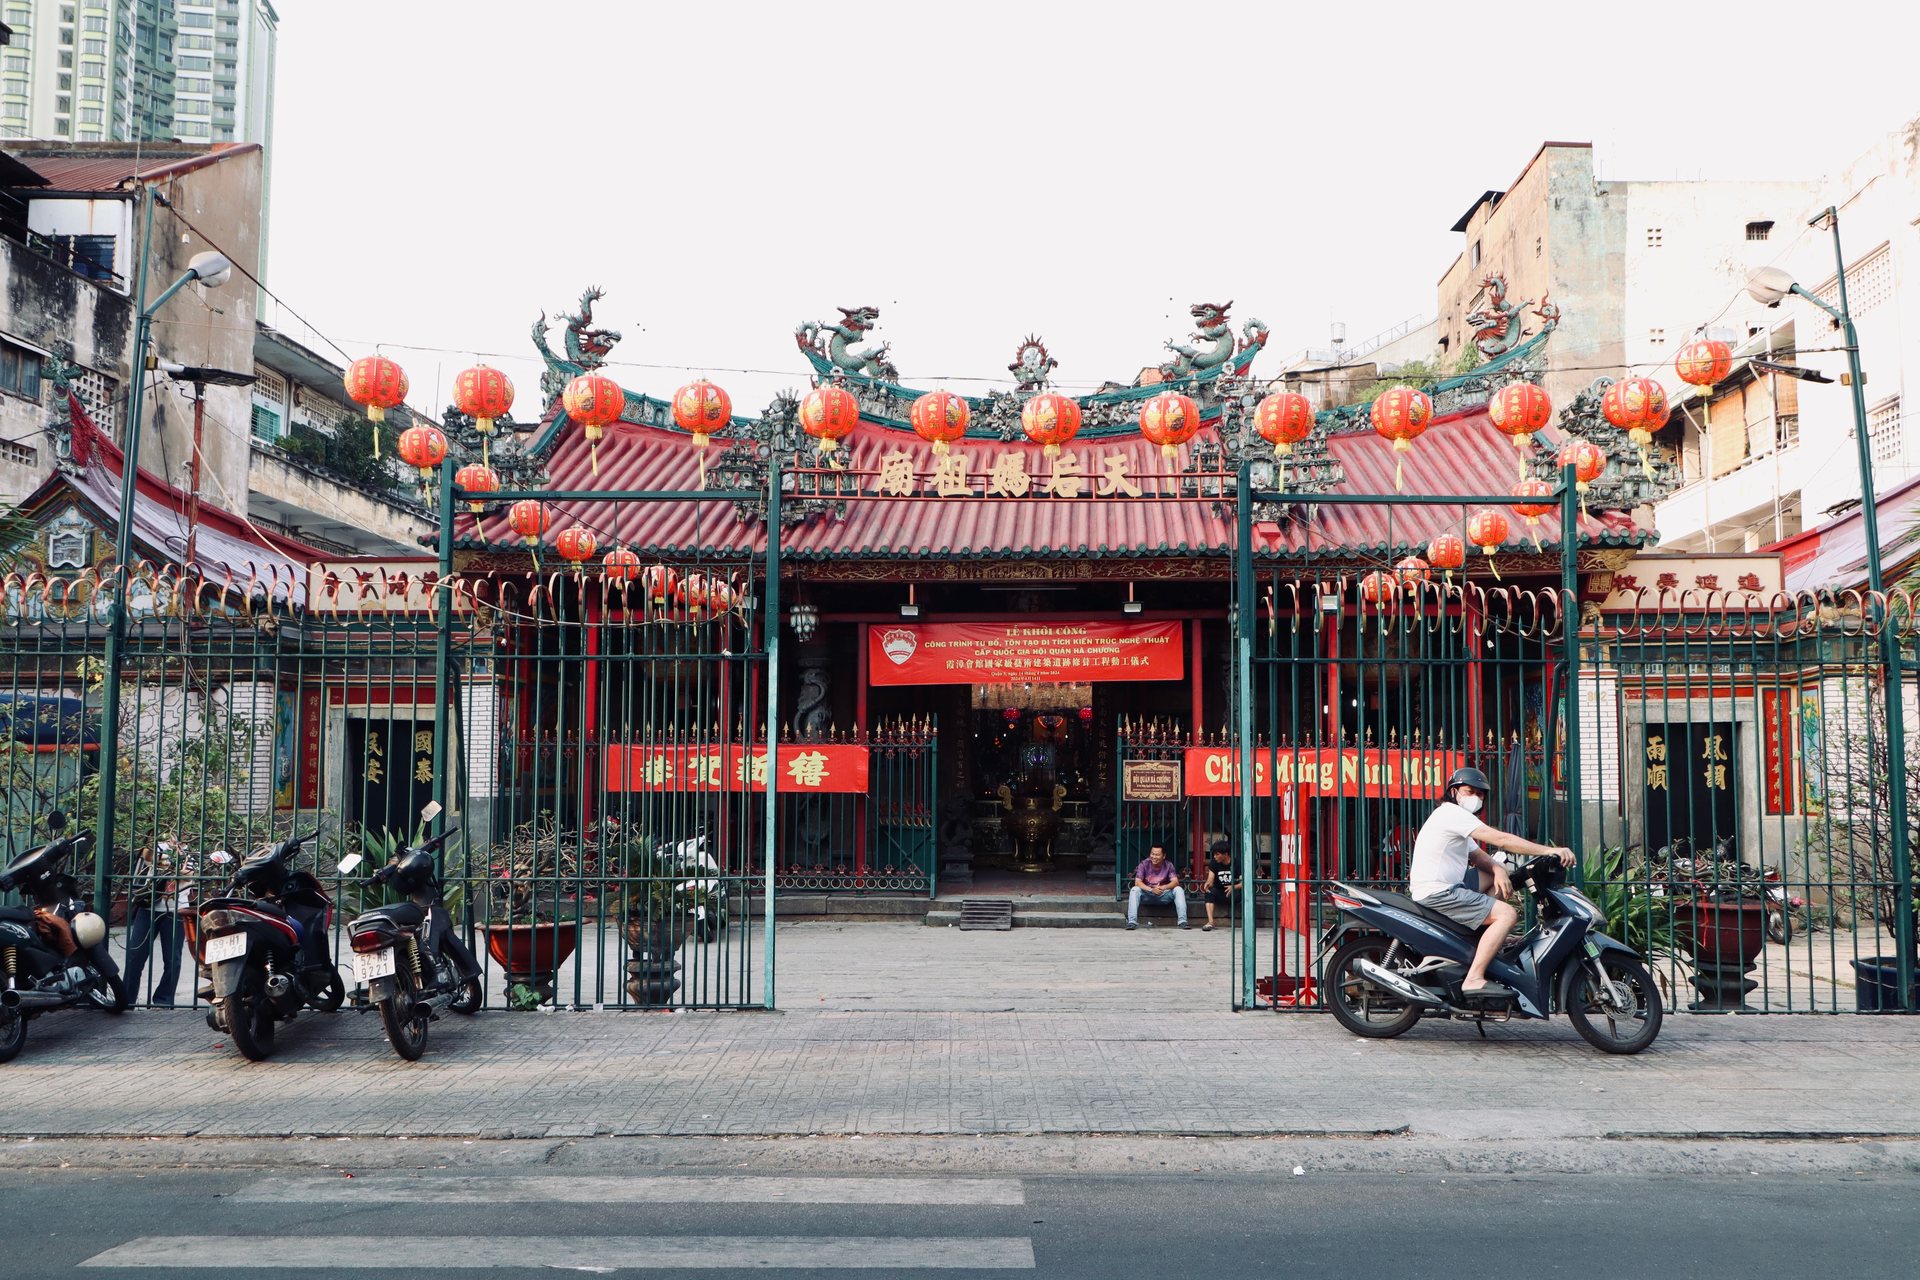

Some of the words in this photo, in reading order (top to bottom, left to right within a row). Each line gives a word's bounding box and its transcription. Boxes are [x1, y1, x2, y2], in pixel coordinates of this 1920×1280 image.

[1055, 626, 1087, 636] CÔNG
[924, 640, 947, 649] CÔNG
[949, 640, 973, 648] TRÌNH
[1004, 638, 1021, 647] TÔN
[1052, 637, 1070, 646] TÍCH
[1095, 636, 1117, 645] TRÚC
[1017, 648, 1031, 656] GIA
[1049, 646, 1072, 656] QUÁN
[1074, 645, 1085, 654] HÀ
[1587, 691, 1607, 702] 82
[362, 731, 384, 784] 民安
[414, 730, 434, 784] 國泰
[1646, 735, 1667, 791] 雨順
[1702, 734, 1728, 790] 風調
[361, 962, 388, 979] 9221
